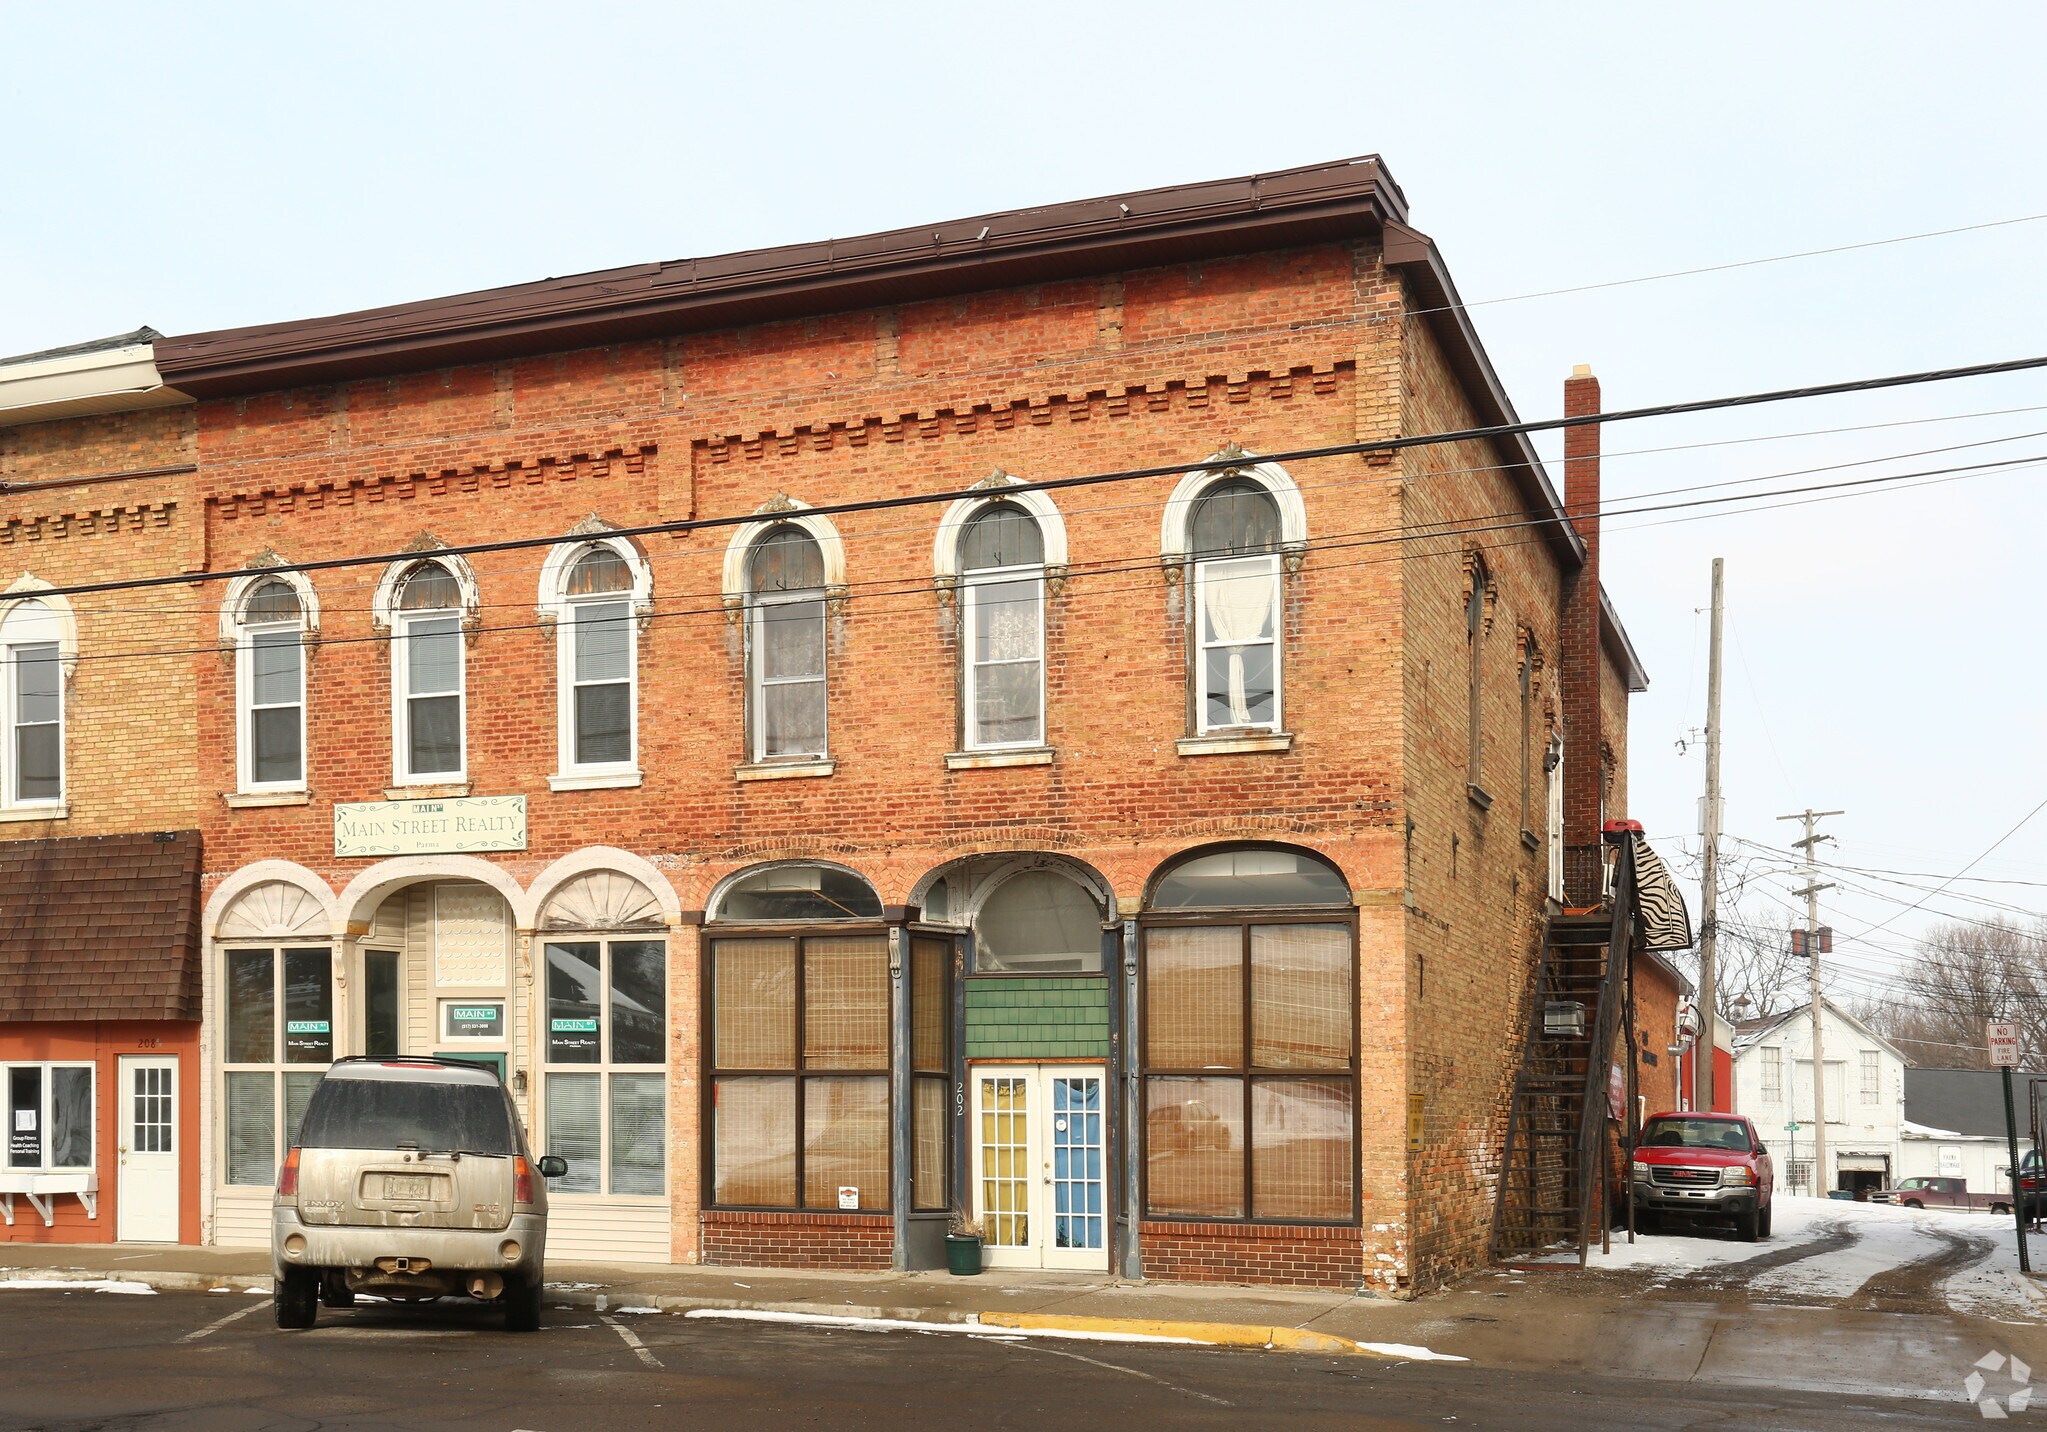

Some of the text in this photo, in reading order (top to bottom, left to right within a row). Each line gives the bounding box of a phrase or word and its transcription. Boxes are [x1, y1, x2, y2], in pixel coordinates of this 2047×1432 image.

[413, 804, 437, 813] MAIN
[342, 815, 517, 838] MAIN STREET REALTY
[456, 1010, 485, 1018] MAIN
[553, 1021, 585, 1029] MAIN
[1996, 1028, 2008, 1036] NO
[137, 1038, 156, 1049] 208
[1991, 1037, 2016, 1045] PARKING
[956, 1081, 964, 1117] 202
